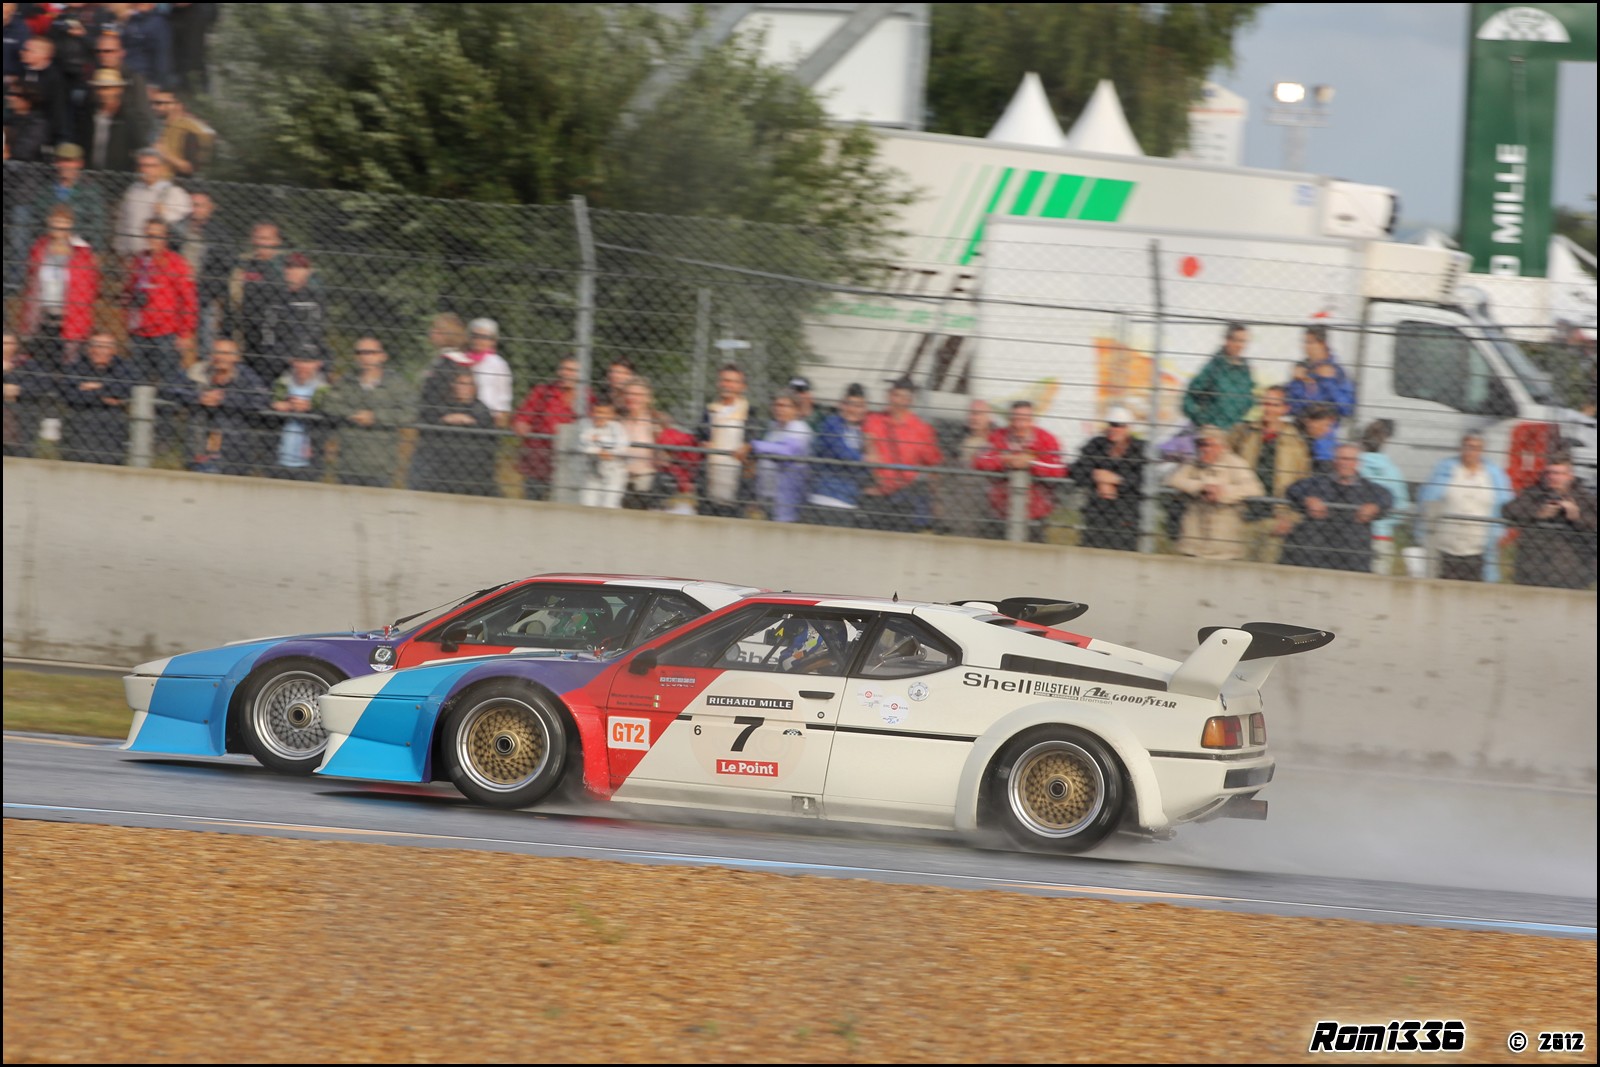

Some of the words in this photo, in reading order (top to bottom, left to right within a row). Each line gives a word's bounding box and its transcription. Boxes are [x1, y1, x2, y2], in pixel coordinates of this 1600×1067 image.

[1491, 144, 1527, 243] MILLE
[963, 672, 1032, 694] Shell
[1034, 681, 1080, 696] BILSTEIN
[709, 697, 757, 706] RICHARD
[759, 700, 792, 709] MILLE
[1112, 693, 1177, 708] GOODYEAR
[612, 722, 645, 744] GT2
[694, 724, 702, 736] 6
[730, 716, 765, 752] 7
[721, 762, 736, 773] Le
[738, 762, 774, 775] Point
